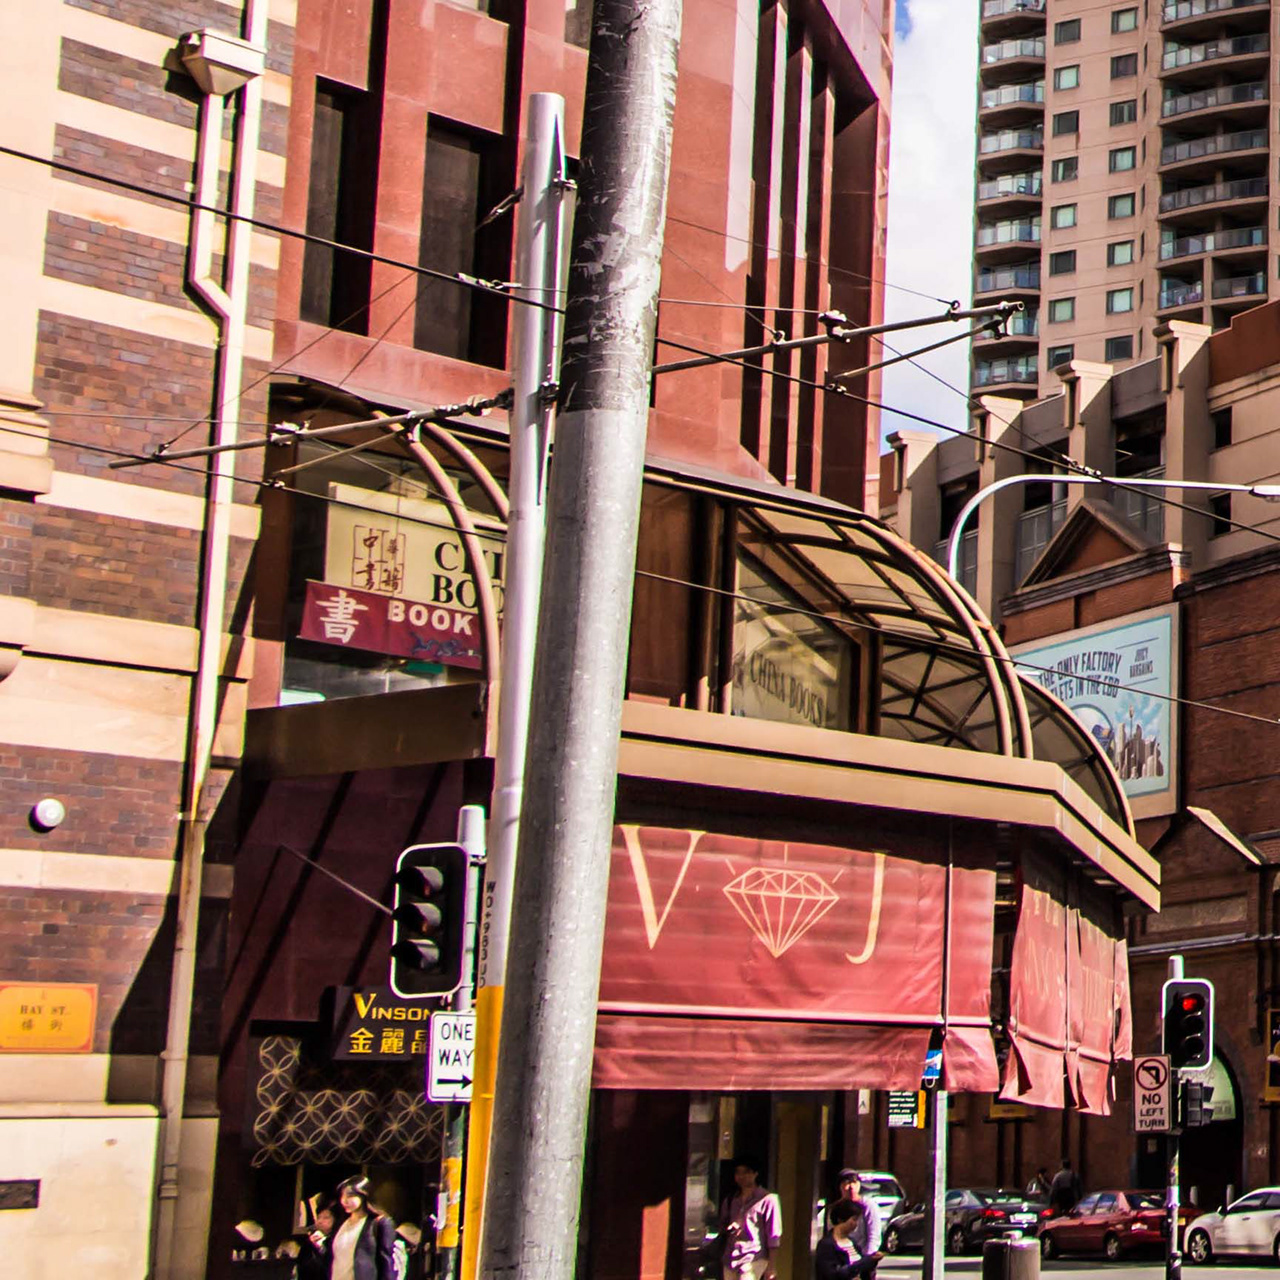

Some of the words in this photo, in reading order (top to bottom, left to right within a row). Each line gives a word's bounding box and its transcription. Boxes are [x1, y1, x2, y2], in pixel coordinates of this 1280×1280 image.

[315, 589, 369, 644] 書
[387, 600, 474, 637] BOOK
[1039, 665, 1055, 687] THE
[1057, 654, 1081, 681] ONLY
[1081, 650, 1122, 675] FACTORY
[619, 823, 706, 950] V
[845, 852, 886, 965] J
[441, 1022, 473, 1041] ONE
[438, 1048, 475, 1067] WAY
[1141, 1092, 1162, 1106] NO
[1139, 1107, 1165, 1118] LEFT
[1138, 1119, 1166, 1129] TURN
